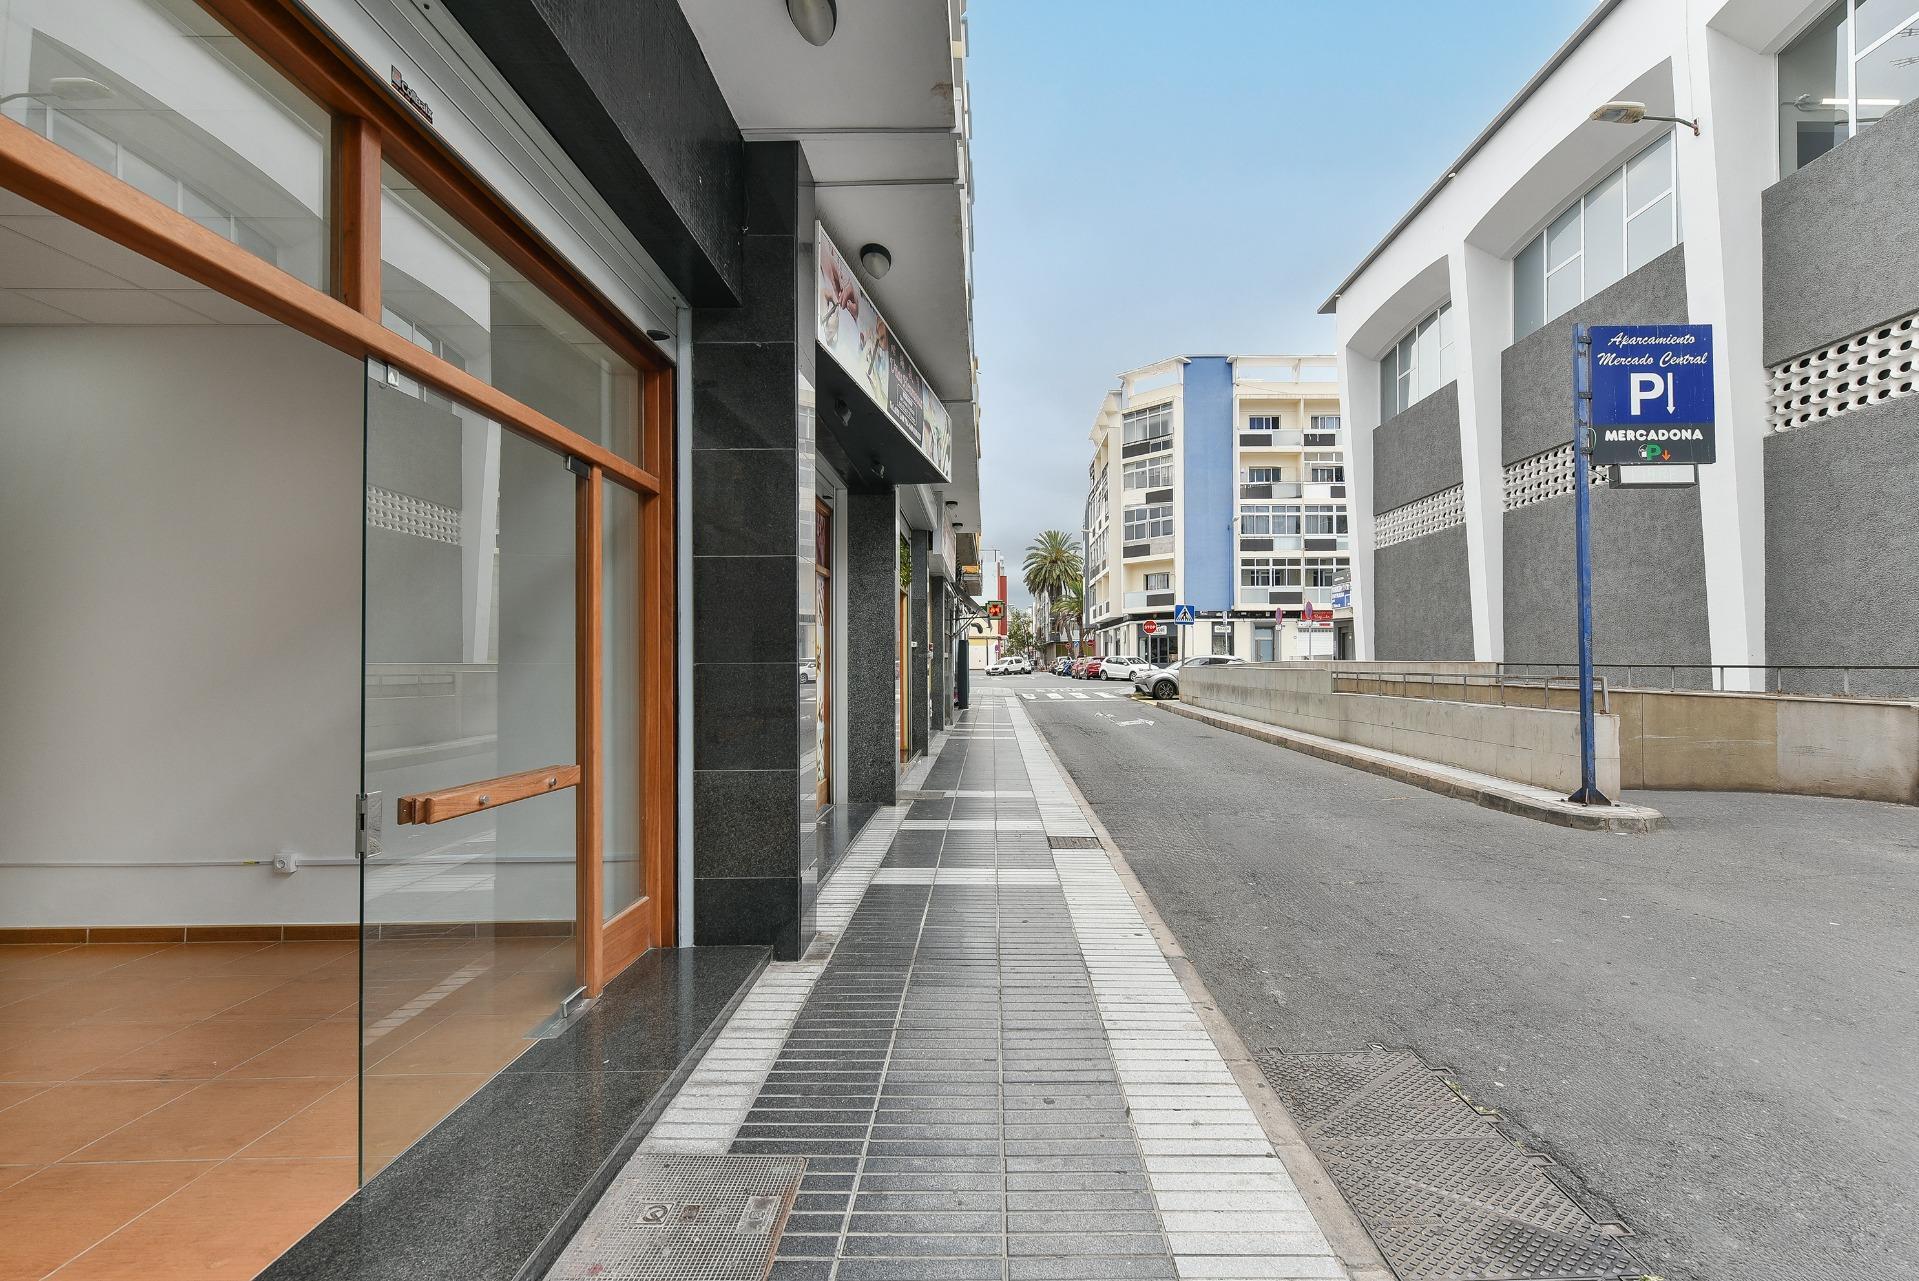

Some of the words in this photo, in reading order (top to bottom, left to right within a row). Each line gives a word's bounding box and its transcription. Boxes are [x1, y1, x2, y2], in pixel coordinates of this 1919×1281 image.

[1608, 332, 1696, 348] Aparcamiento
[1597, 352, 1654, 366] Mercado
[1659, 351, 1708, 367] Central
[1630, 372, 1665, 415] P
[1604, 428, 1704, 441] MERCADONA
